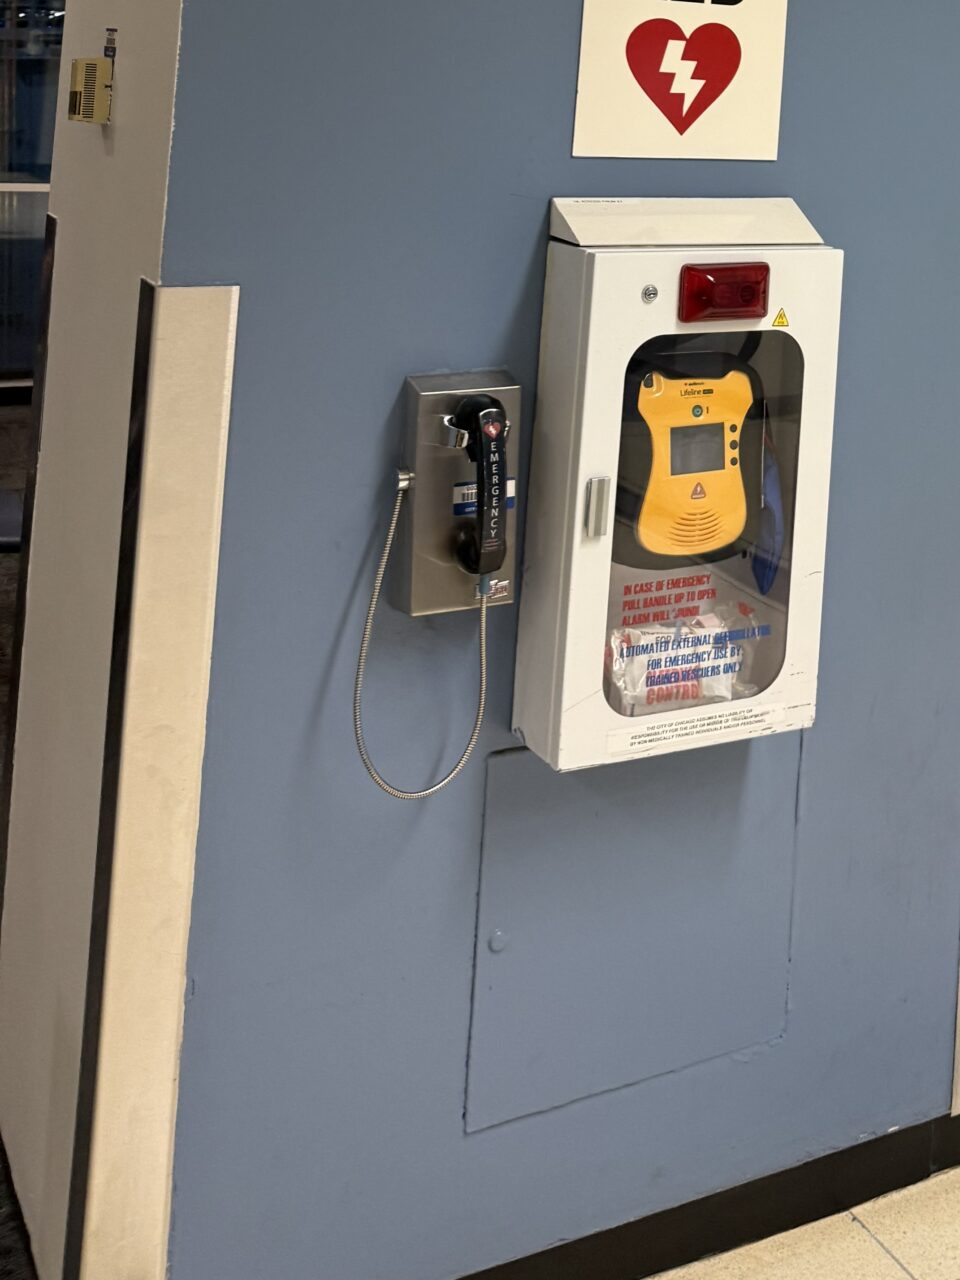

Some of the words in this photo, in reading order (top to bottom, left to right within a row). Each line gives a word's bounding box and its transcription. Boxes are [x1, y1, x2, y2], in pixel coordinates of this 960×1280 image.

[680, 388, 702, 397] Lifeline
[490, 442, 500, 538] EMERGENCY
[623, 584, 632, 596] IN
[634, 581, 654, 595] CASE
[655, 580, 666, 592] OF
[666, 573, 712, 590] EMERGENCY
[623, 598, 641, 612] PULL
[643, 594, 673, 609] HANDLE
[674, 592, 685, 604] UP
[687, 590, 696, 602] TO
[697, 587, 718, 601] OPEN
[622, 612, 650, 627] ALARM
[652, 609, 670, 622] WILL
[620, 640, 670, 658] AUTOMATED
[671, 634, 711, 651] EXTERNAL
[647, 657, 662, 671] FOR
[664, 650, 712, 668] EMERGENCY
[713, 646, 729, 660] USE
[730, 645, 742, 657] BY
[646, 671, 680, 688] TRAINED
[681, 665, 721, 682] RESCUERS
[723, 661, 743, 674] ONLY
[646, 681, 700, 705] CONTRO
